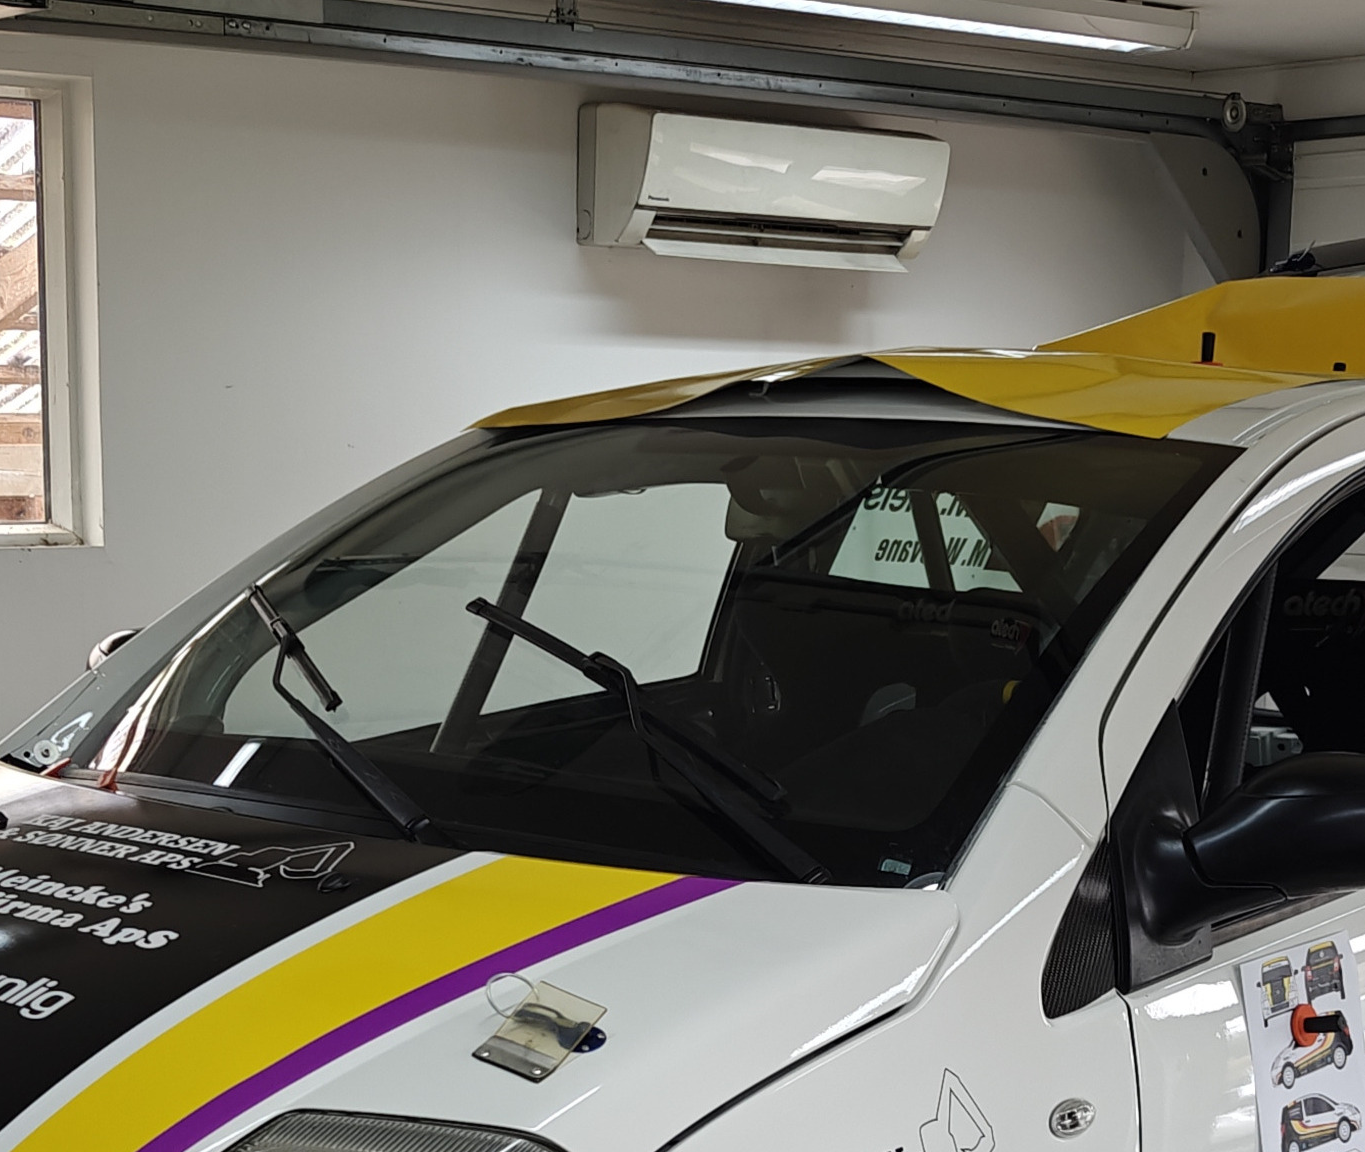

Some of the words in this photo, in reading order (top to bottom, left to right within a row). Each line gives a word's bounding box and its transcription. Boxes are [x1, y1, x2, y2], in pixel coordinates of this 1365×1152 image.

[14, 831, 139, 858] SØNNER
[128, 850, 202, 870] APS
[22, 814, 86, 832] KAJ
[78, 821, 241, 856] ANDERSEN
[78, 917, 179, 949] ApS
